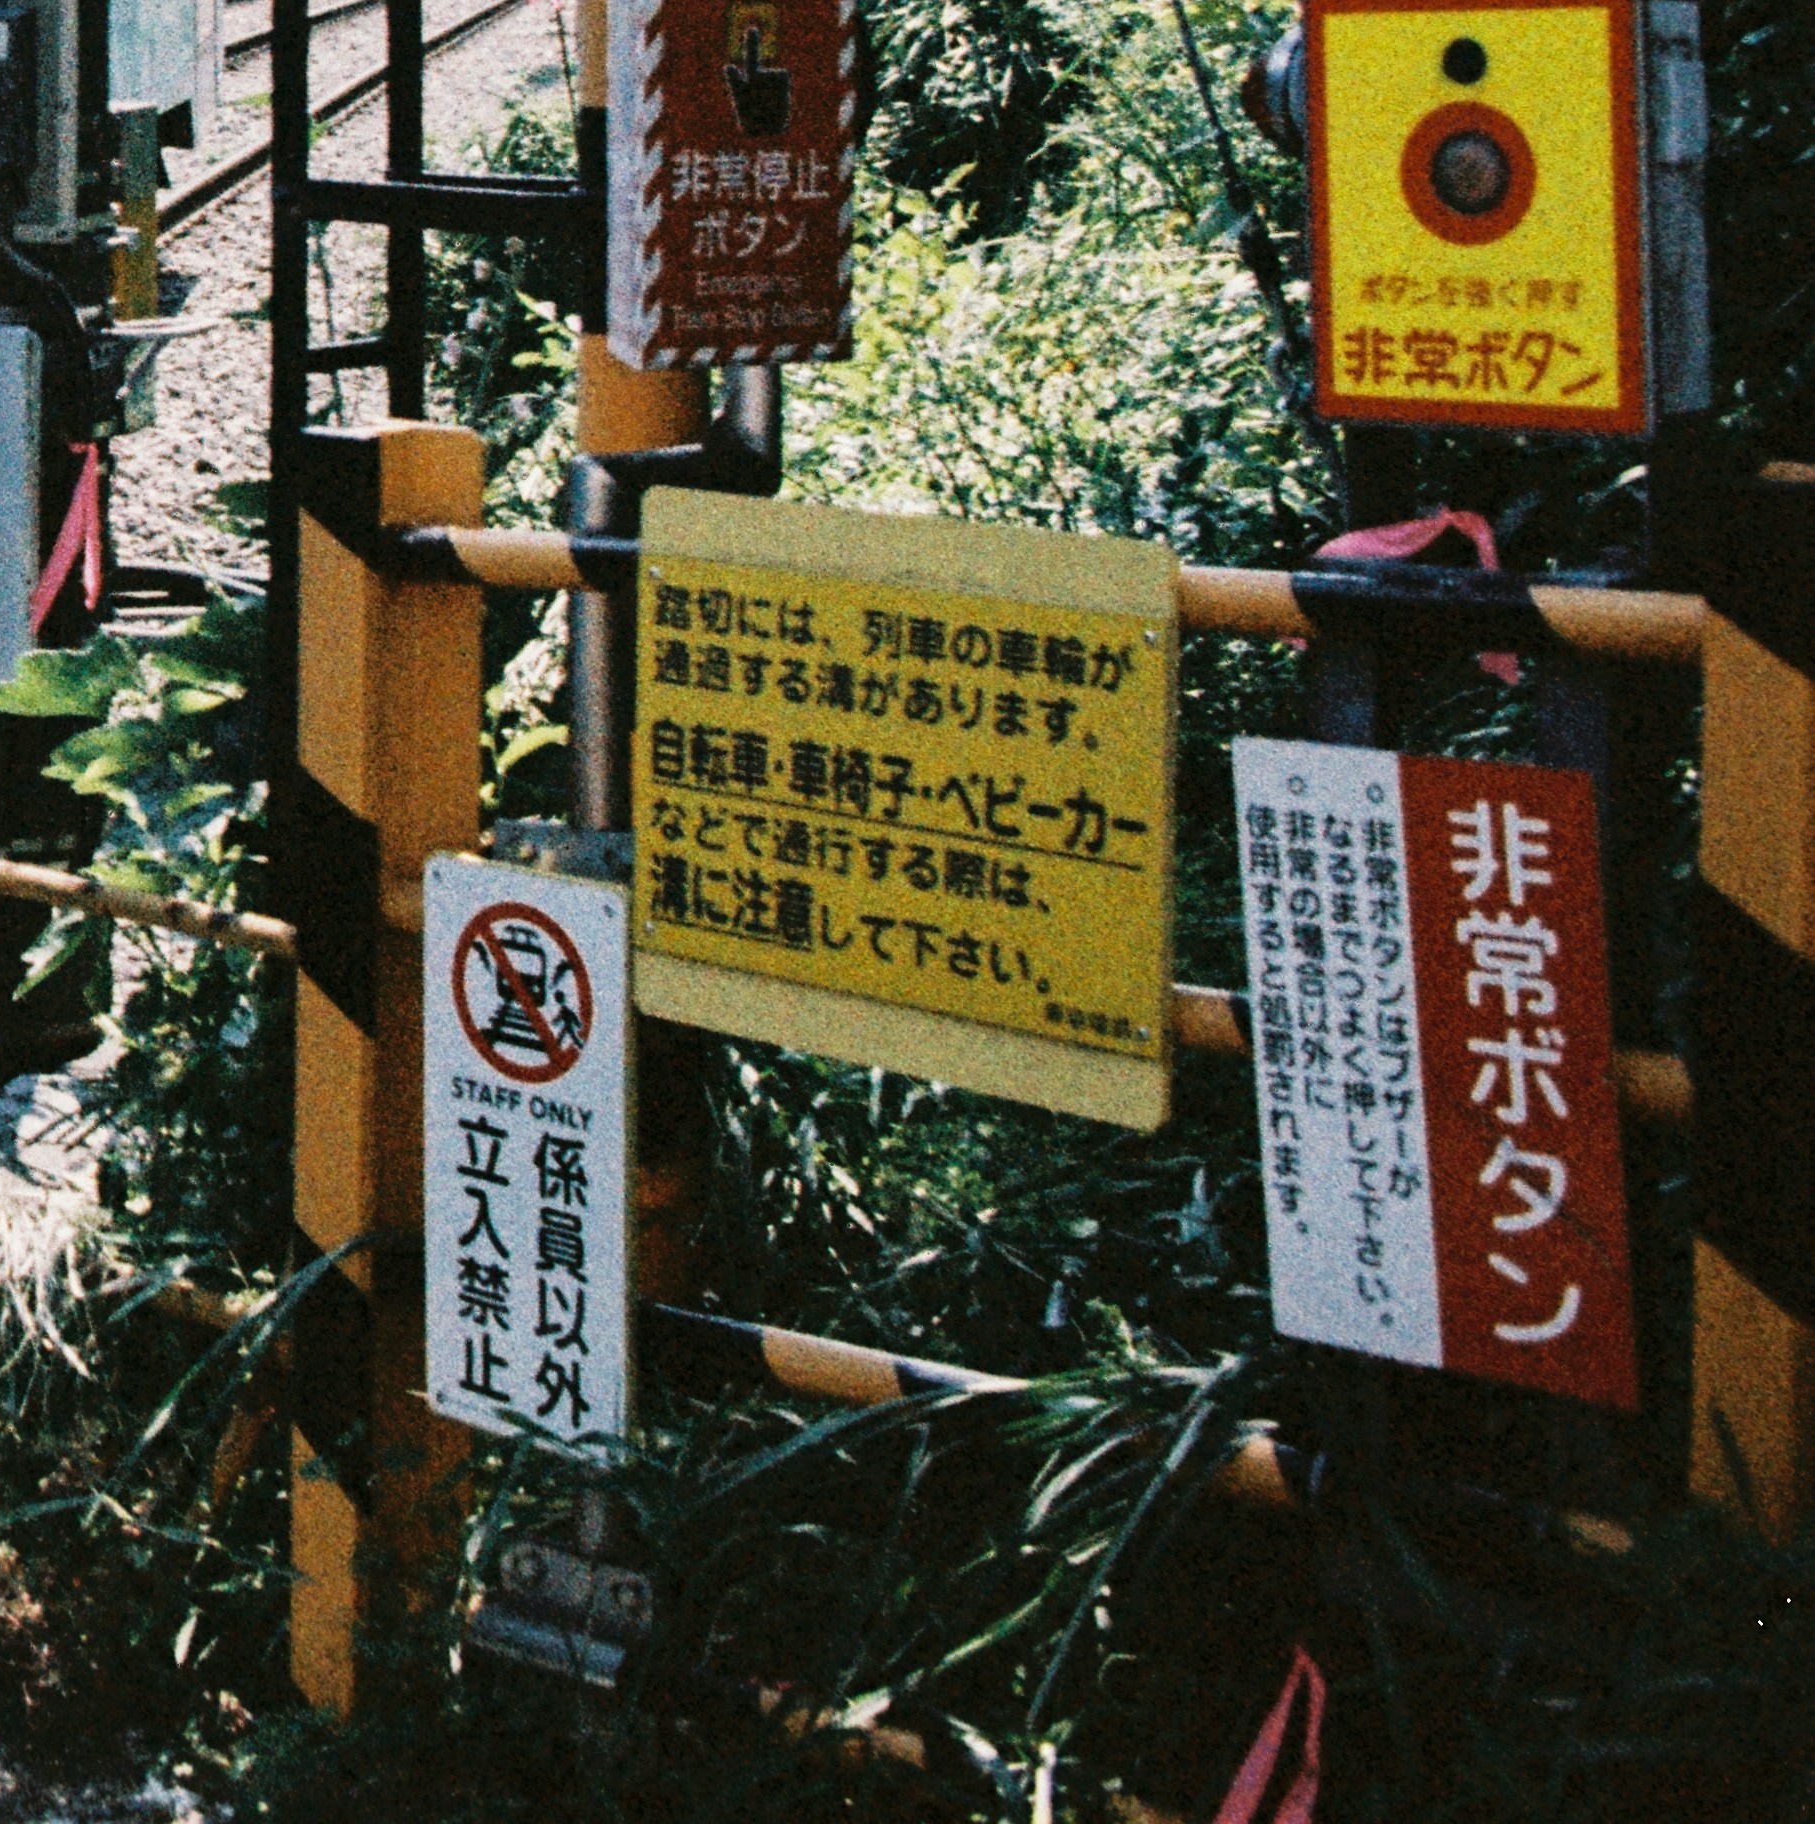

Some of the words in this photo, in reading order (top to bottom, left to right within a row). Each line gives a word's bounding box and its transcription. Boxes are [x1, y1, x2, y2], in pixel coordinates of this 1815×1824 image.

[671, 148, 830, 202] 非常停止
[693, 208, 808, 259] ボタン
[1343, 326, 1603, 397] 非常ボタン
[652, 639, 1100, 753] 通過する溝があります。
[650, 797, 1051, 914] などで通行する際は、
[650, 854, 1051, 994] 溝に注意して下さい。
[1284, 809, 1336, 1111] 非常の場合以外に
[451, 1075, 522, 1113] STAFF
[530, 1094, 595, 1133] ONLY
[1446, 798, 1581, 1344] 非常ボタン
[456, 1115, 511, 1405] 立入禁止
[532, 1131, 590, 1430] 係員以外
